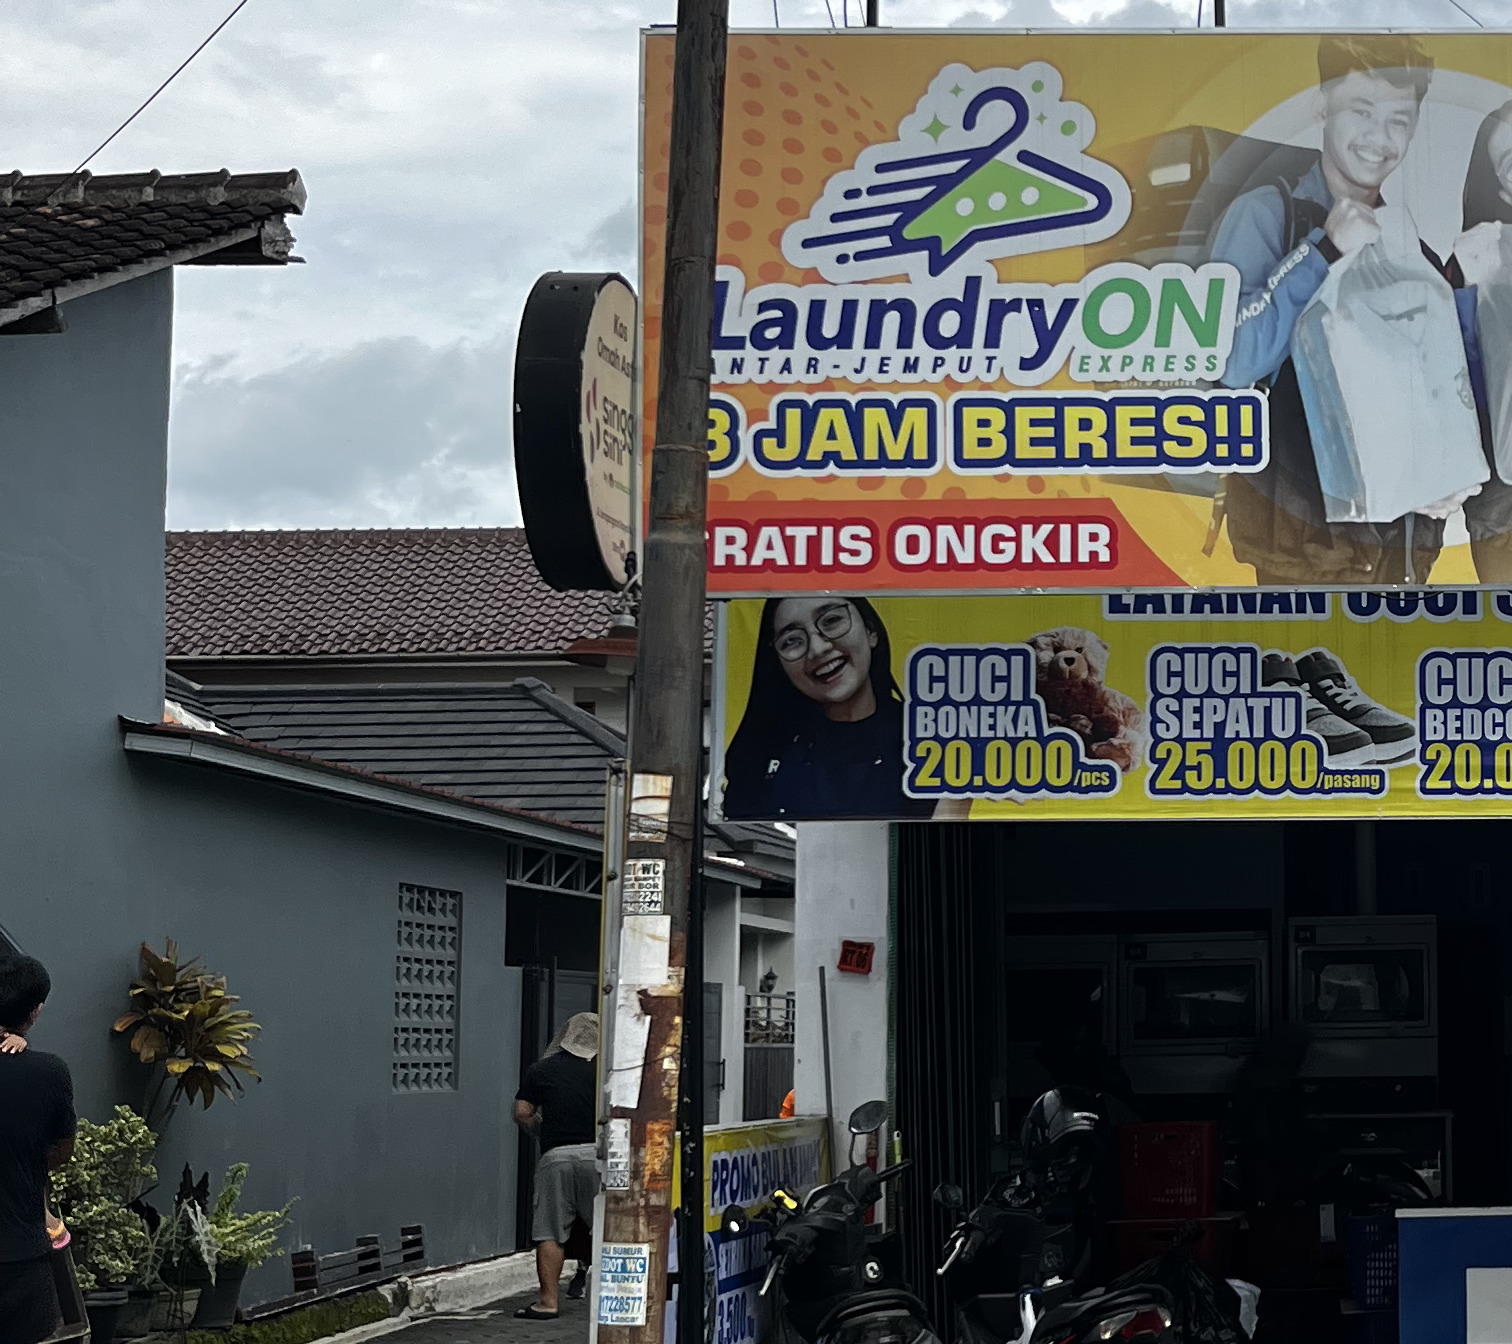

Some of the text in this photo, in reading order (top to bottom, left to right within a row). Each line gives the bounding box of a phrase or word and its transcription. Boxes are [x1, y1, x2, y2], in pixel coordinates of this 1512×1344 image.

[1078, 354, 1219, 374] EXPRESS
[762, 406, 929, 462] JAM
[958, 403, 1256, 459] BERES!!
[705, 523, 1112, 567] RATIS ONGKIR
[916, 655, 1024, 703] CUCI
[1155, 651, 1253, 695] CUCI
[915, 705, 1037, 739] BONEKA
[1155, 696, 1298, 740] SEPATU
[641, 862, 661, 875] WC
[711, 1152, 760, 1208] PROMO
[612, 1247, 643, 1256] SUMUR
[626, 1258, 645, 1273] WC
